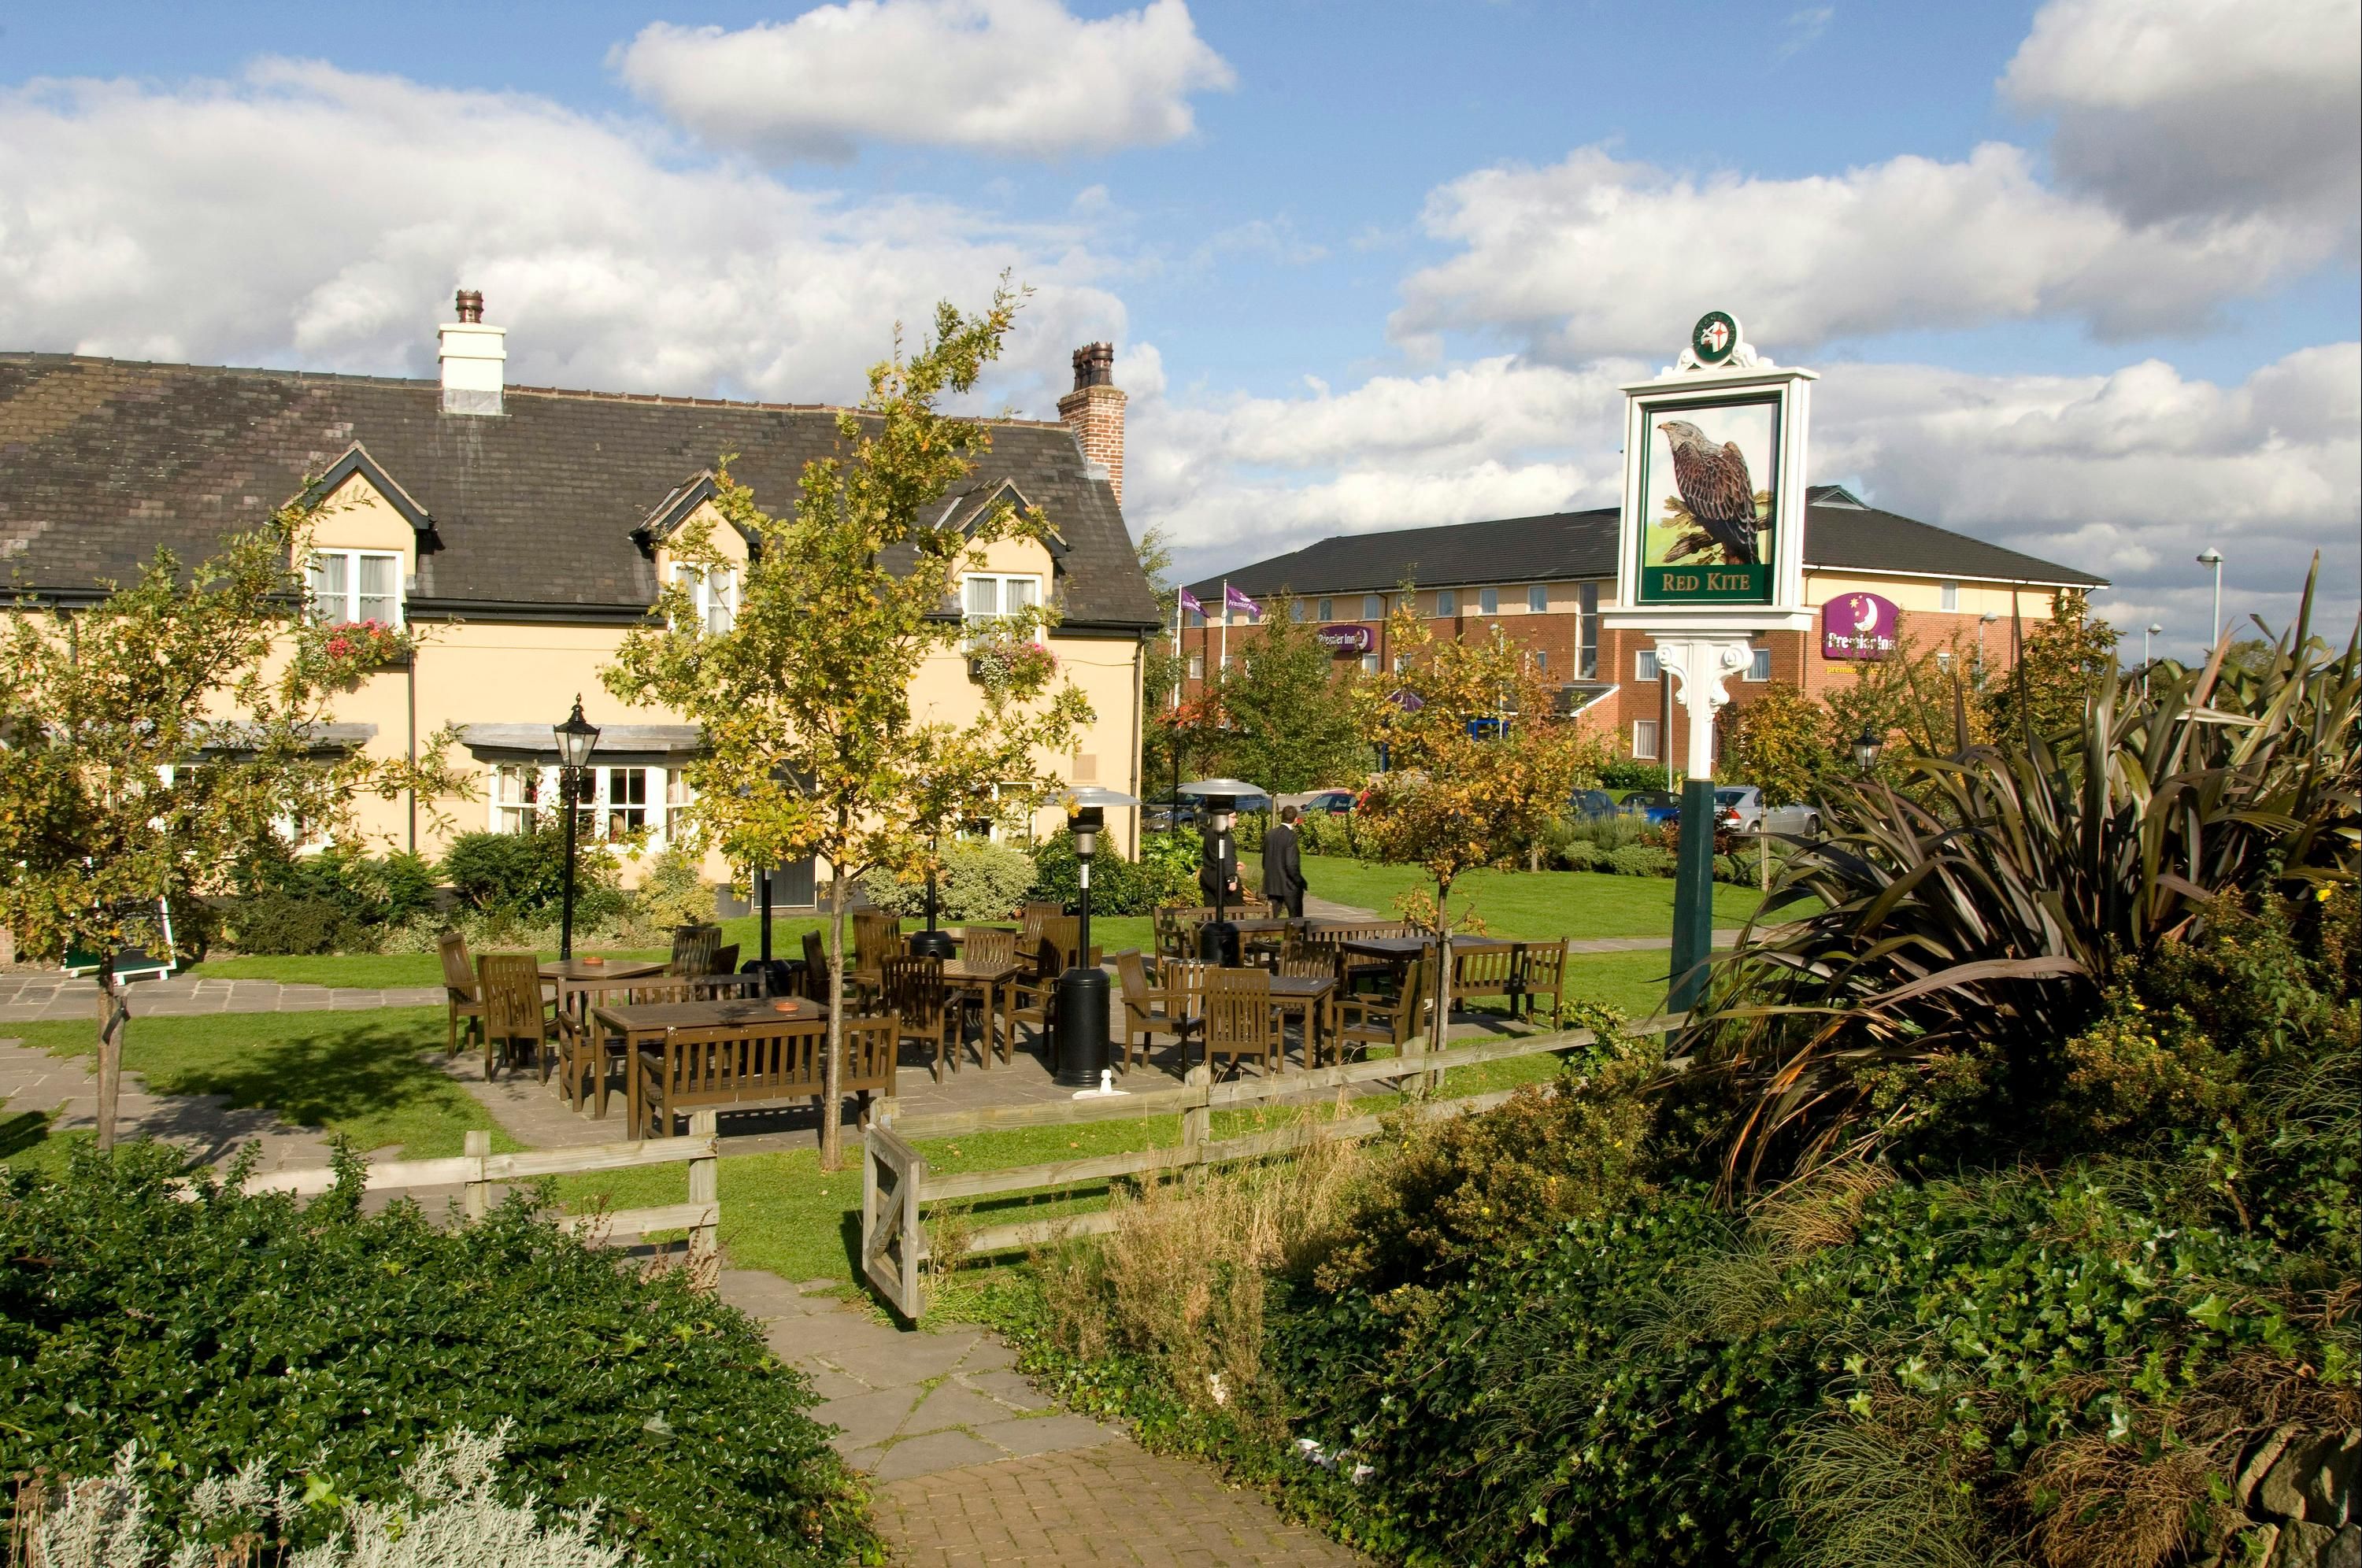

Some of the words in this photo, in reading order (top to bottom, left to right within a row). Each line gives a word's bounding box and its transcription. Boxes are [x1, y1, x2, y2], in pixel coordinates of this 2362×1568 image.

[1661, 573, 1699, 592] RED
[1706, 572, 1751, 591] KITE
[1228, 600, 1249, 608] Premier
[1344, 633, 1355, 644] Inn
